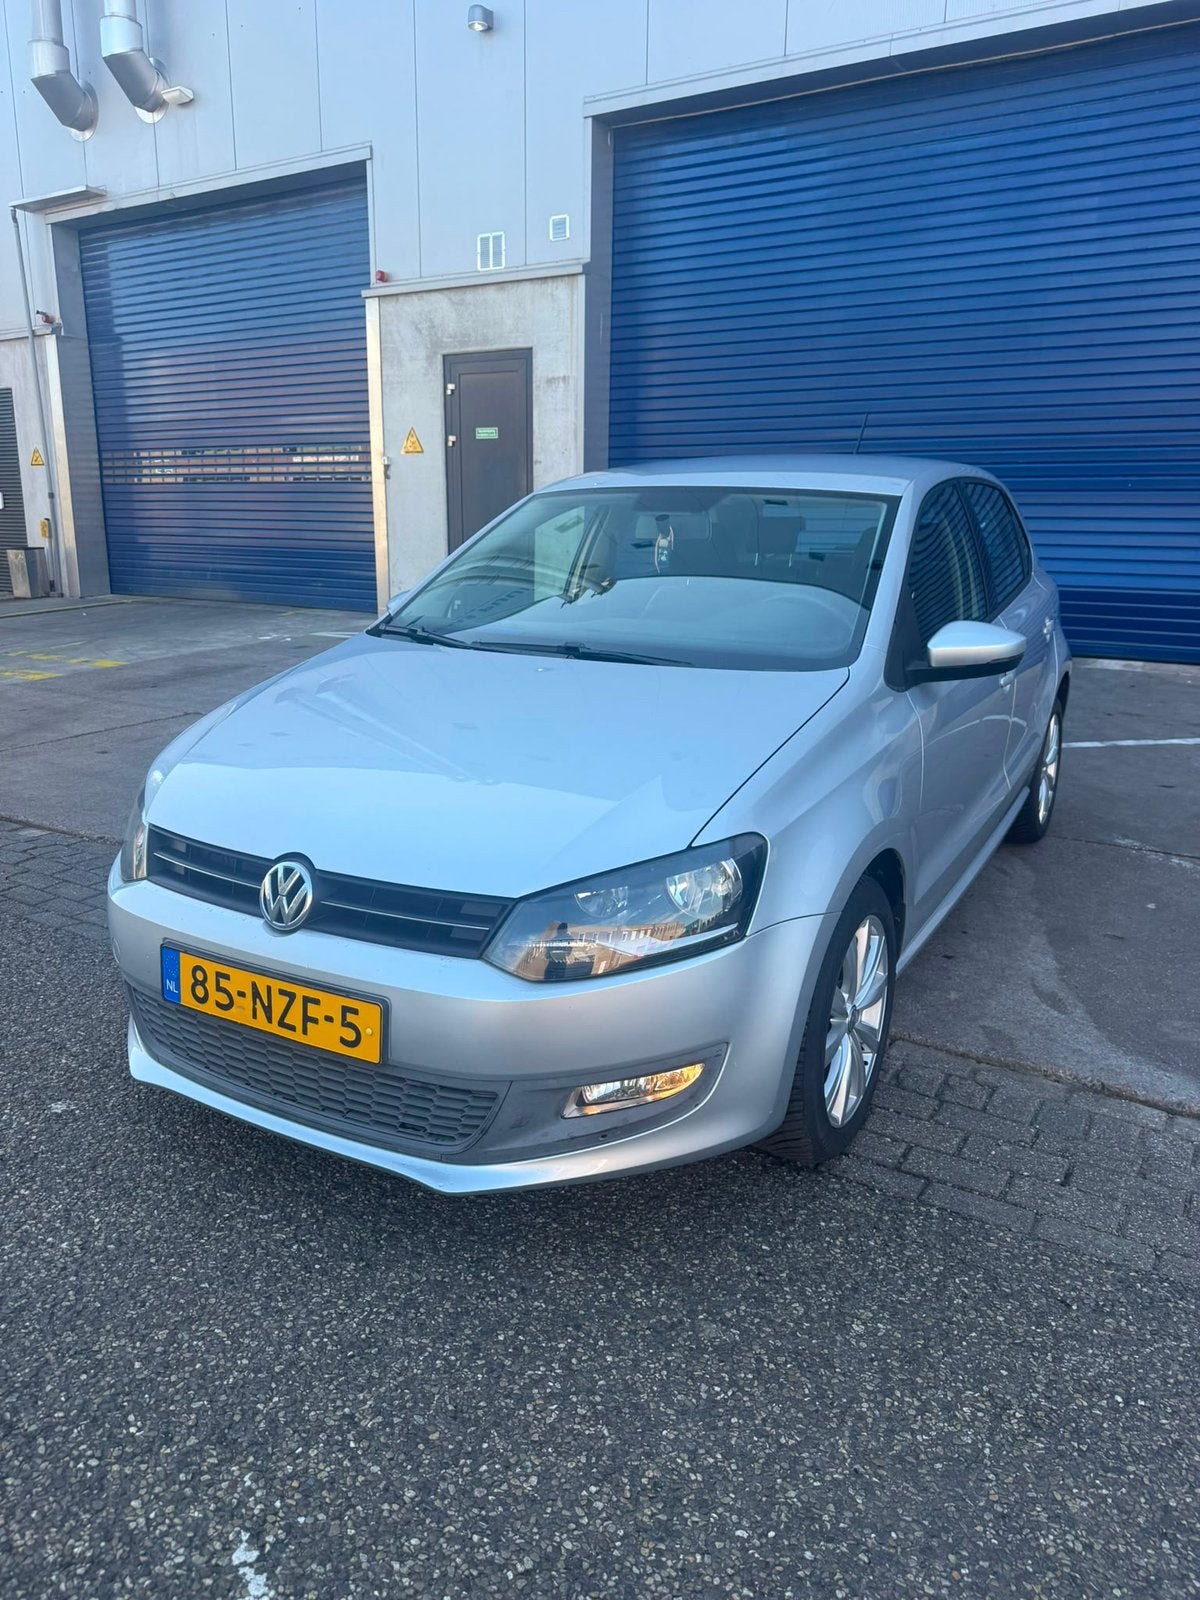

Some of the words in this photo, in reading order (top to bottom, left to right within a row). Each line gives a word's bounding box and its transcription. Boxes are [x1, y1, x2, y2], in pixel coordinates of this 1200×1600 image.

[262, 863, 311, 928] VW
[166, 979, 179, 993] NL
[190, 964, 363, 1049] 85-NZF-5
